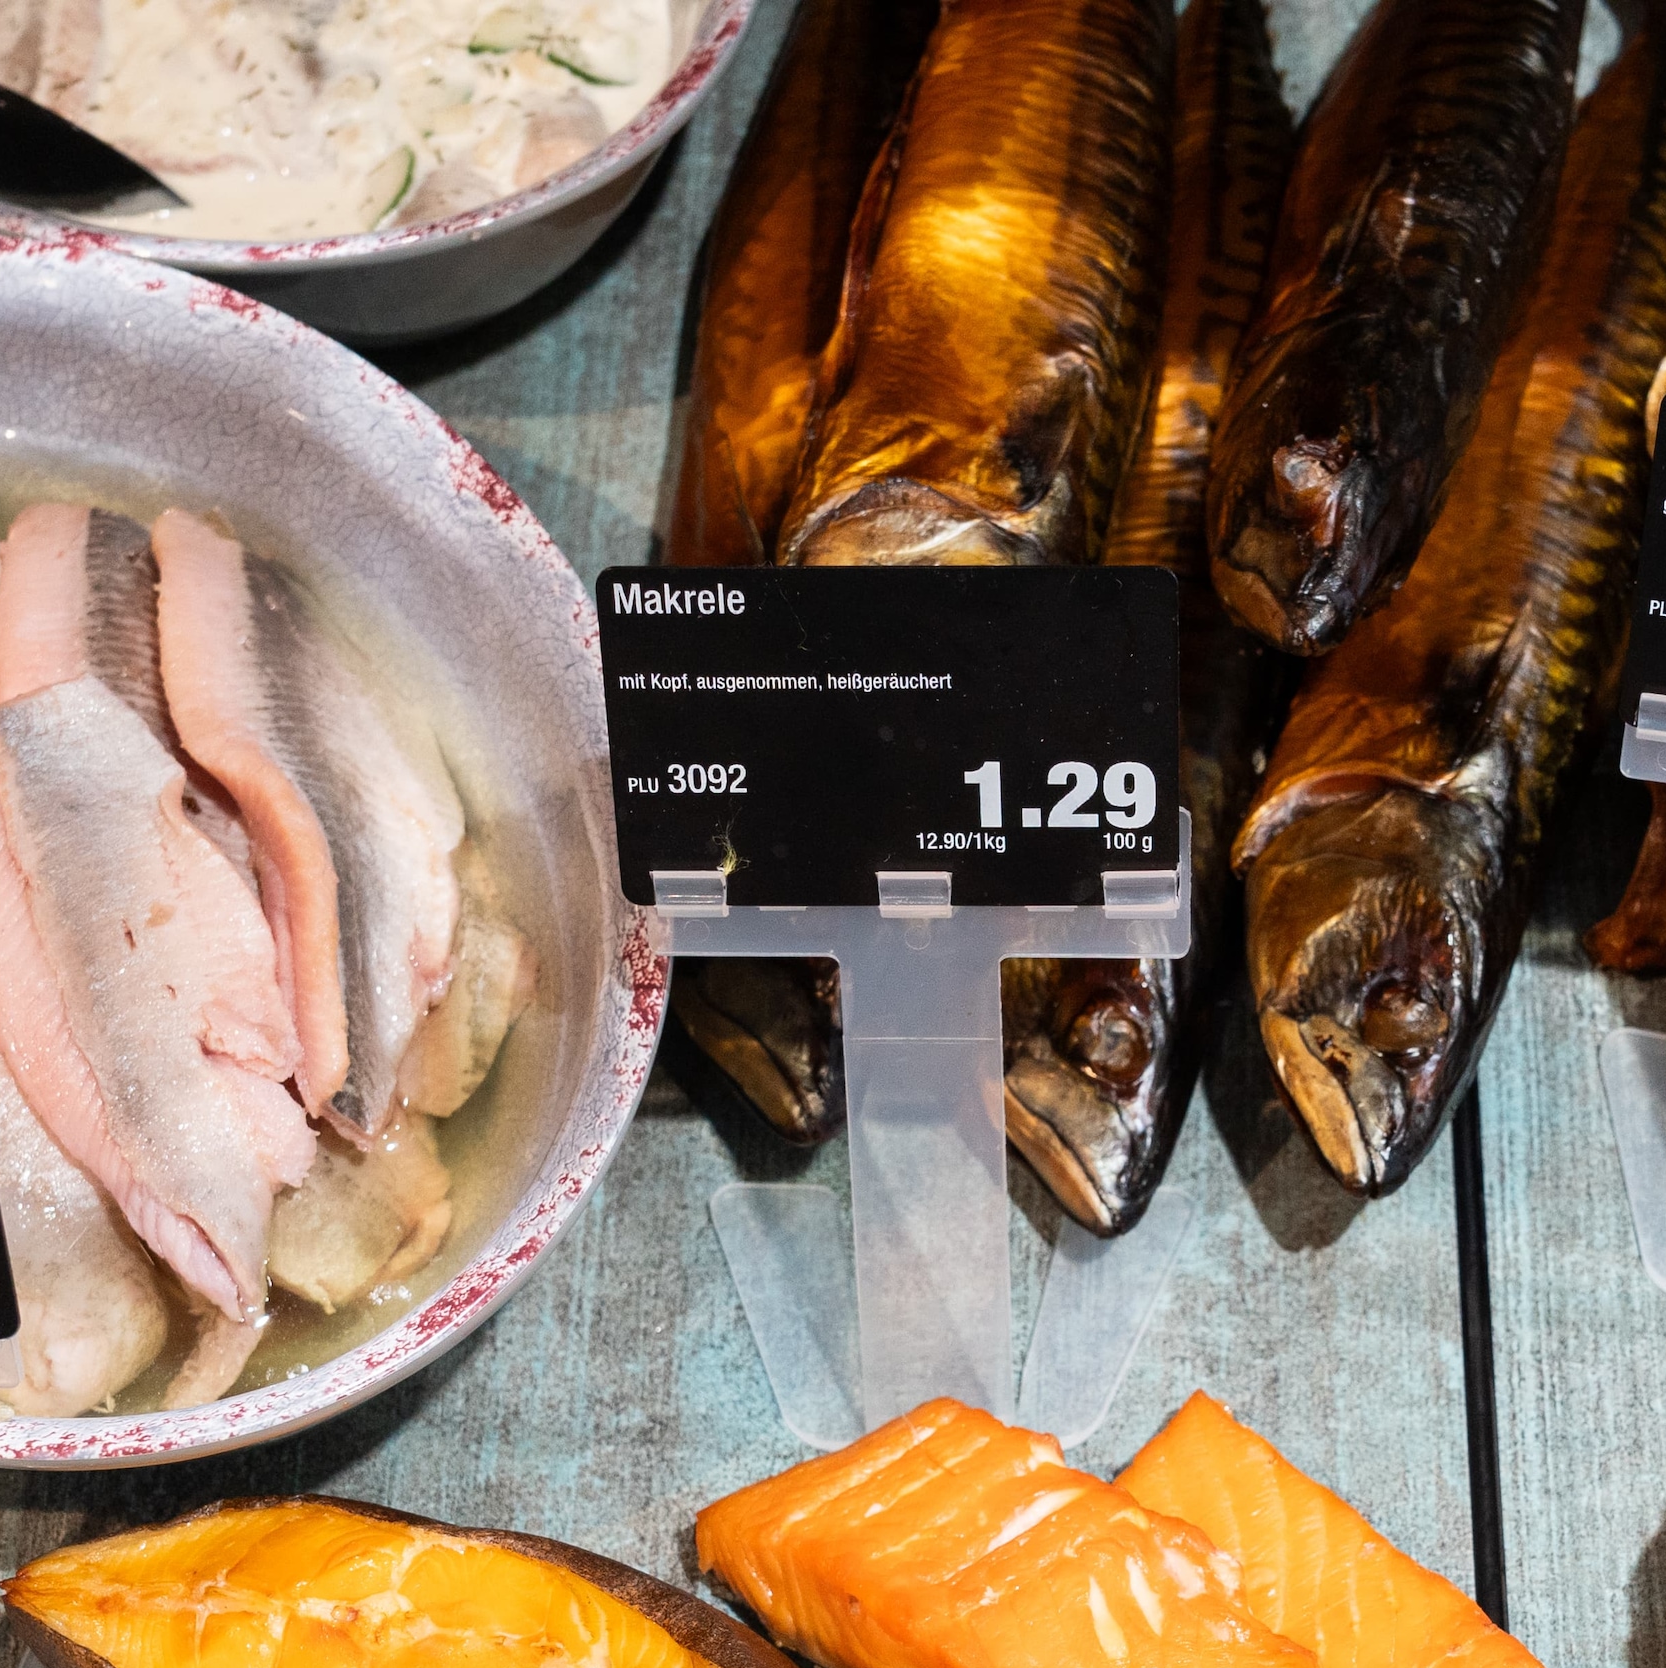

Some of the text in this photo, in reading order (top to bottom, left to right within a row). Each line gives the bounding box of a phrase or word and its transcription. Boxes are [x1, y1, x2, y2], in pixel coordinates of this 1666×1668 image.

[612, 582, 746, 615] Makrele
[618, 672, 953, 693] mit Kopf, ausgenommen, heißgeräuchert
[627, 763, 748, 794] PLU 3092
[963, 760, 1157, 830] 1.29
[915, 831, 1006, 854] 12.90/1kg
[1102, 832, 1153, 853] 100 g
